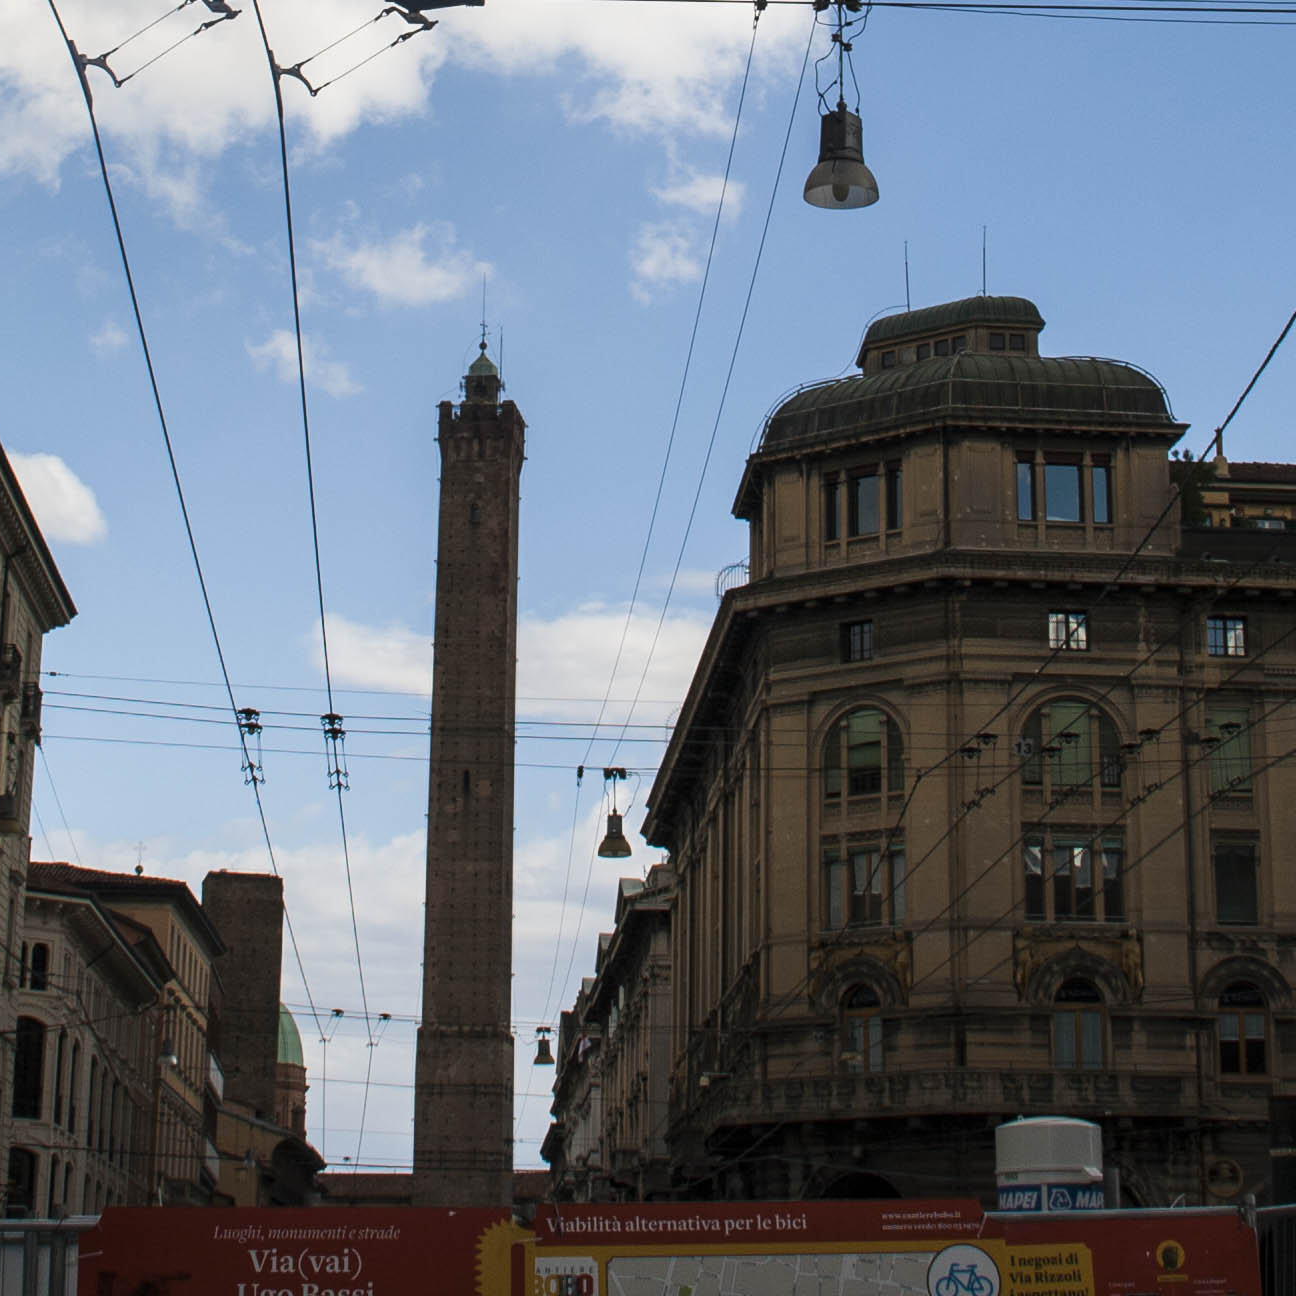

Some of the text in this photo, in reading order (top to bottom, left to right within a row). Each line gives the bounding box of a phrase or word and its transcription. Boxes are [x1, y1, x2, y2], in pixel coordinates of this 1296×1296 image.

[999, 1191, 1038, 1209] MAPEI
[545, 1212, 808, 1236] Viabilità alternativa per le bici
[213, 1225, 401, 1243] Luoghi, monumenti e strade
[248, 1247, 362, 1281] Via(vai)
[1018, 1253, 1063, 1270] negozi
[1065, 1252, 1079, 1265] di
[1009, 1268, 1082, 1283] Via Rizzoli
